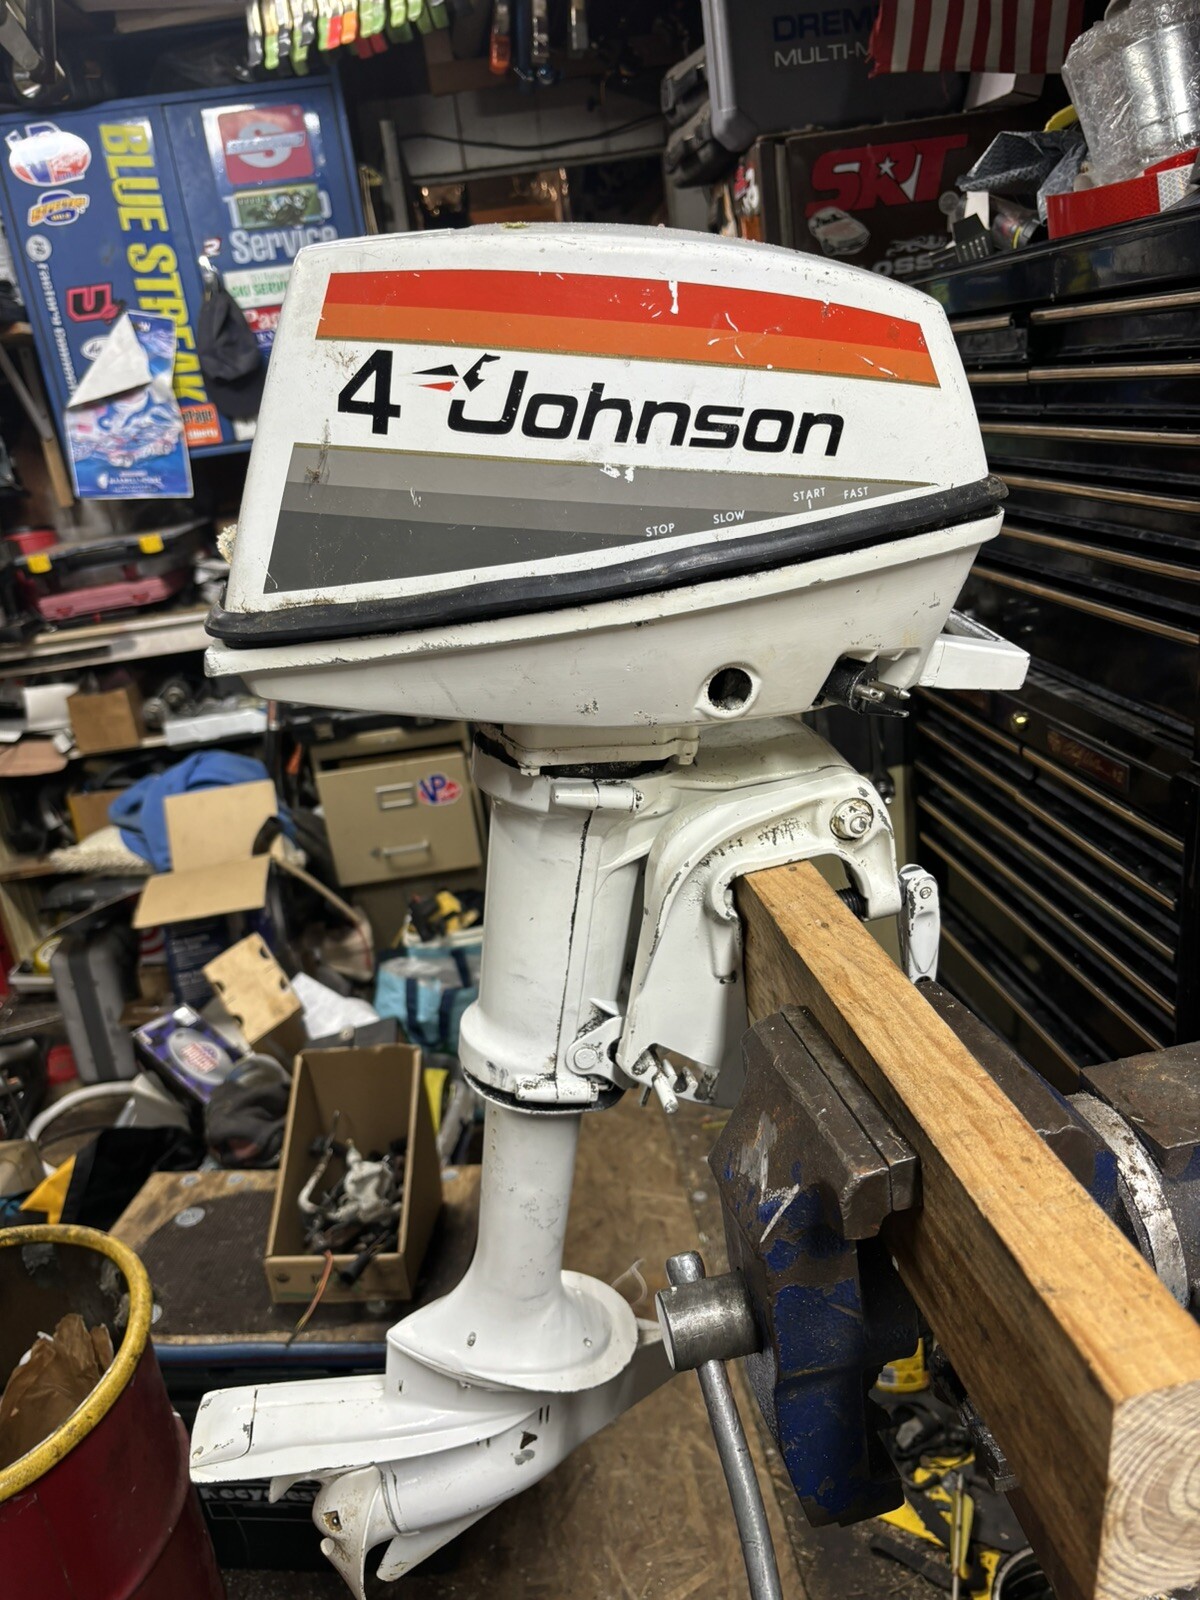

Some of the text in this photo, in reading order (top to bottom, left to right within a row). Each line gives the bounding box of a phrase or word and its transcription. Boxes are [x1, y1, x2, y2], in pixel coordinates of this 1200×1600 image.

[99, 123, 169, 232] BLUE
[804, 134, 968, 218] SRT
[337, 349, 401, 435] 4
[447, 369, 845, 457] Johnson
[645, 486, 869, 538] STOP SLOW START FAST
[419, 774, 446, 803] VP
